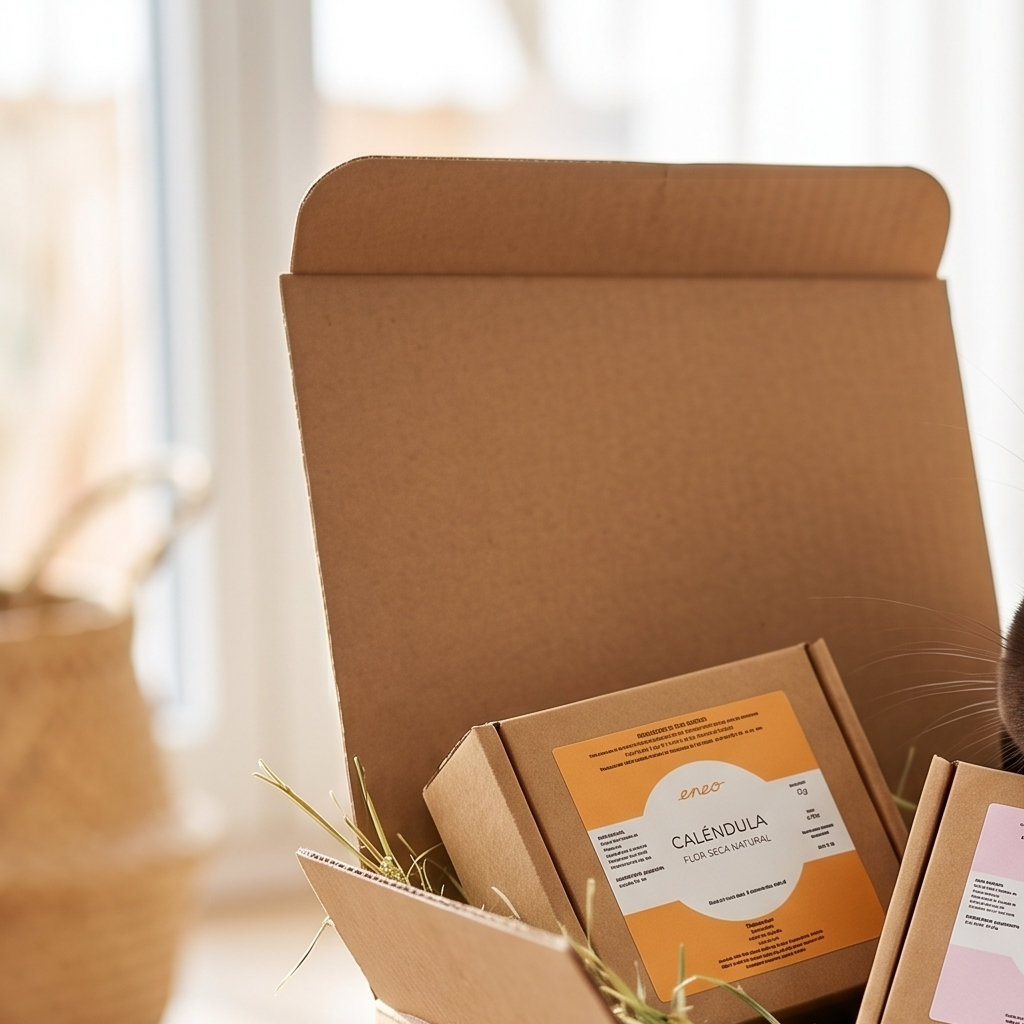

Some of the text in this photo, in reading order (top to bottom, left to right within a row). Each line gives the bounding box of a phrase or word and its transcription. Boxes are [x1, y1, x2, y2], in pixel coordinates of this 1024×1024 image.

[678, 781, 725, 800] eneo
[672, 815, 768, 849] CALÉNDULA
[708, 845, 730, 857] SECA
[731, 834, 771, 851] NATURAL
